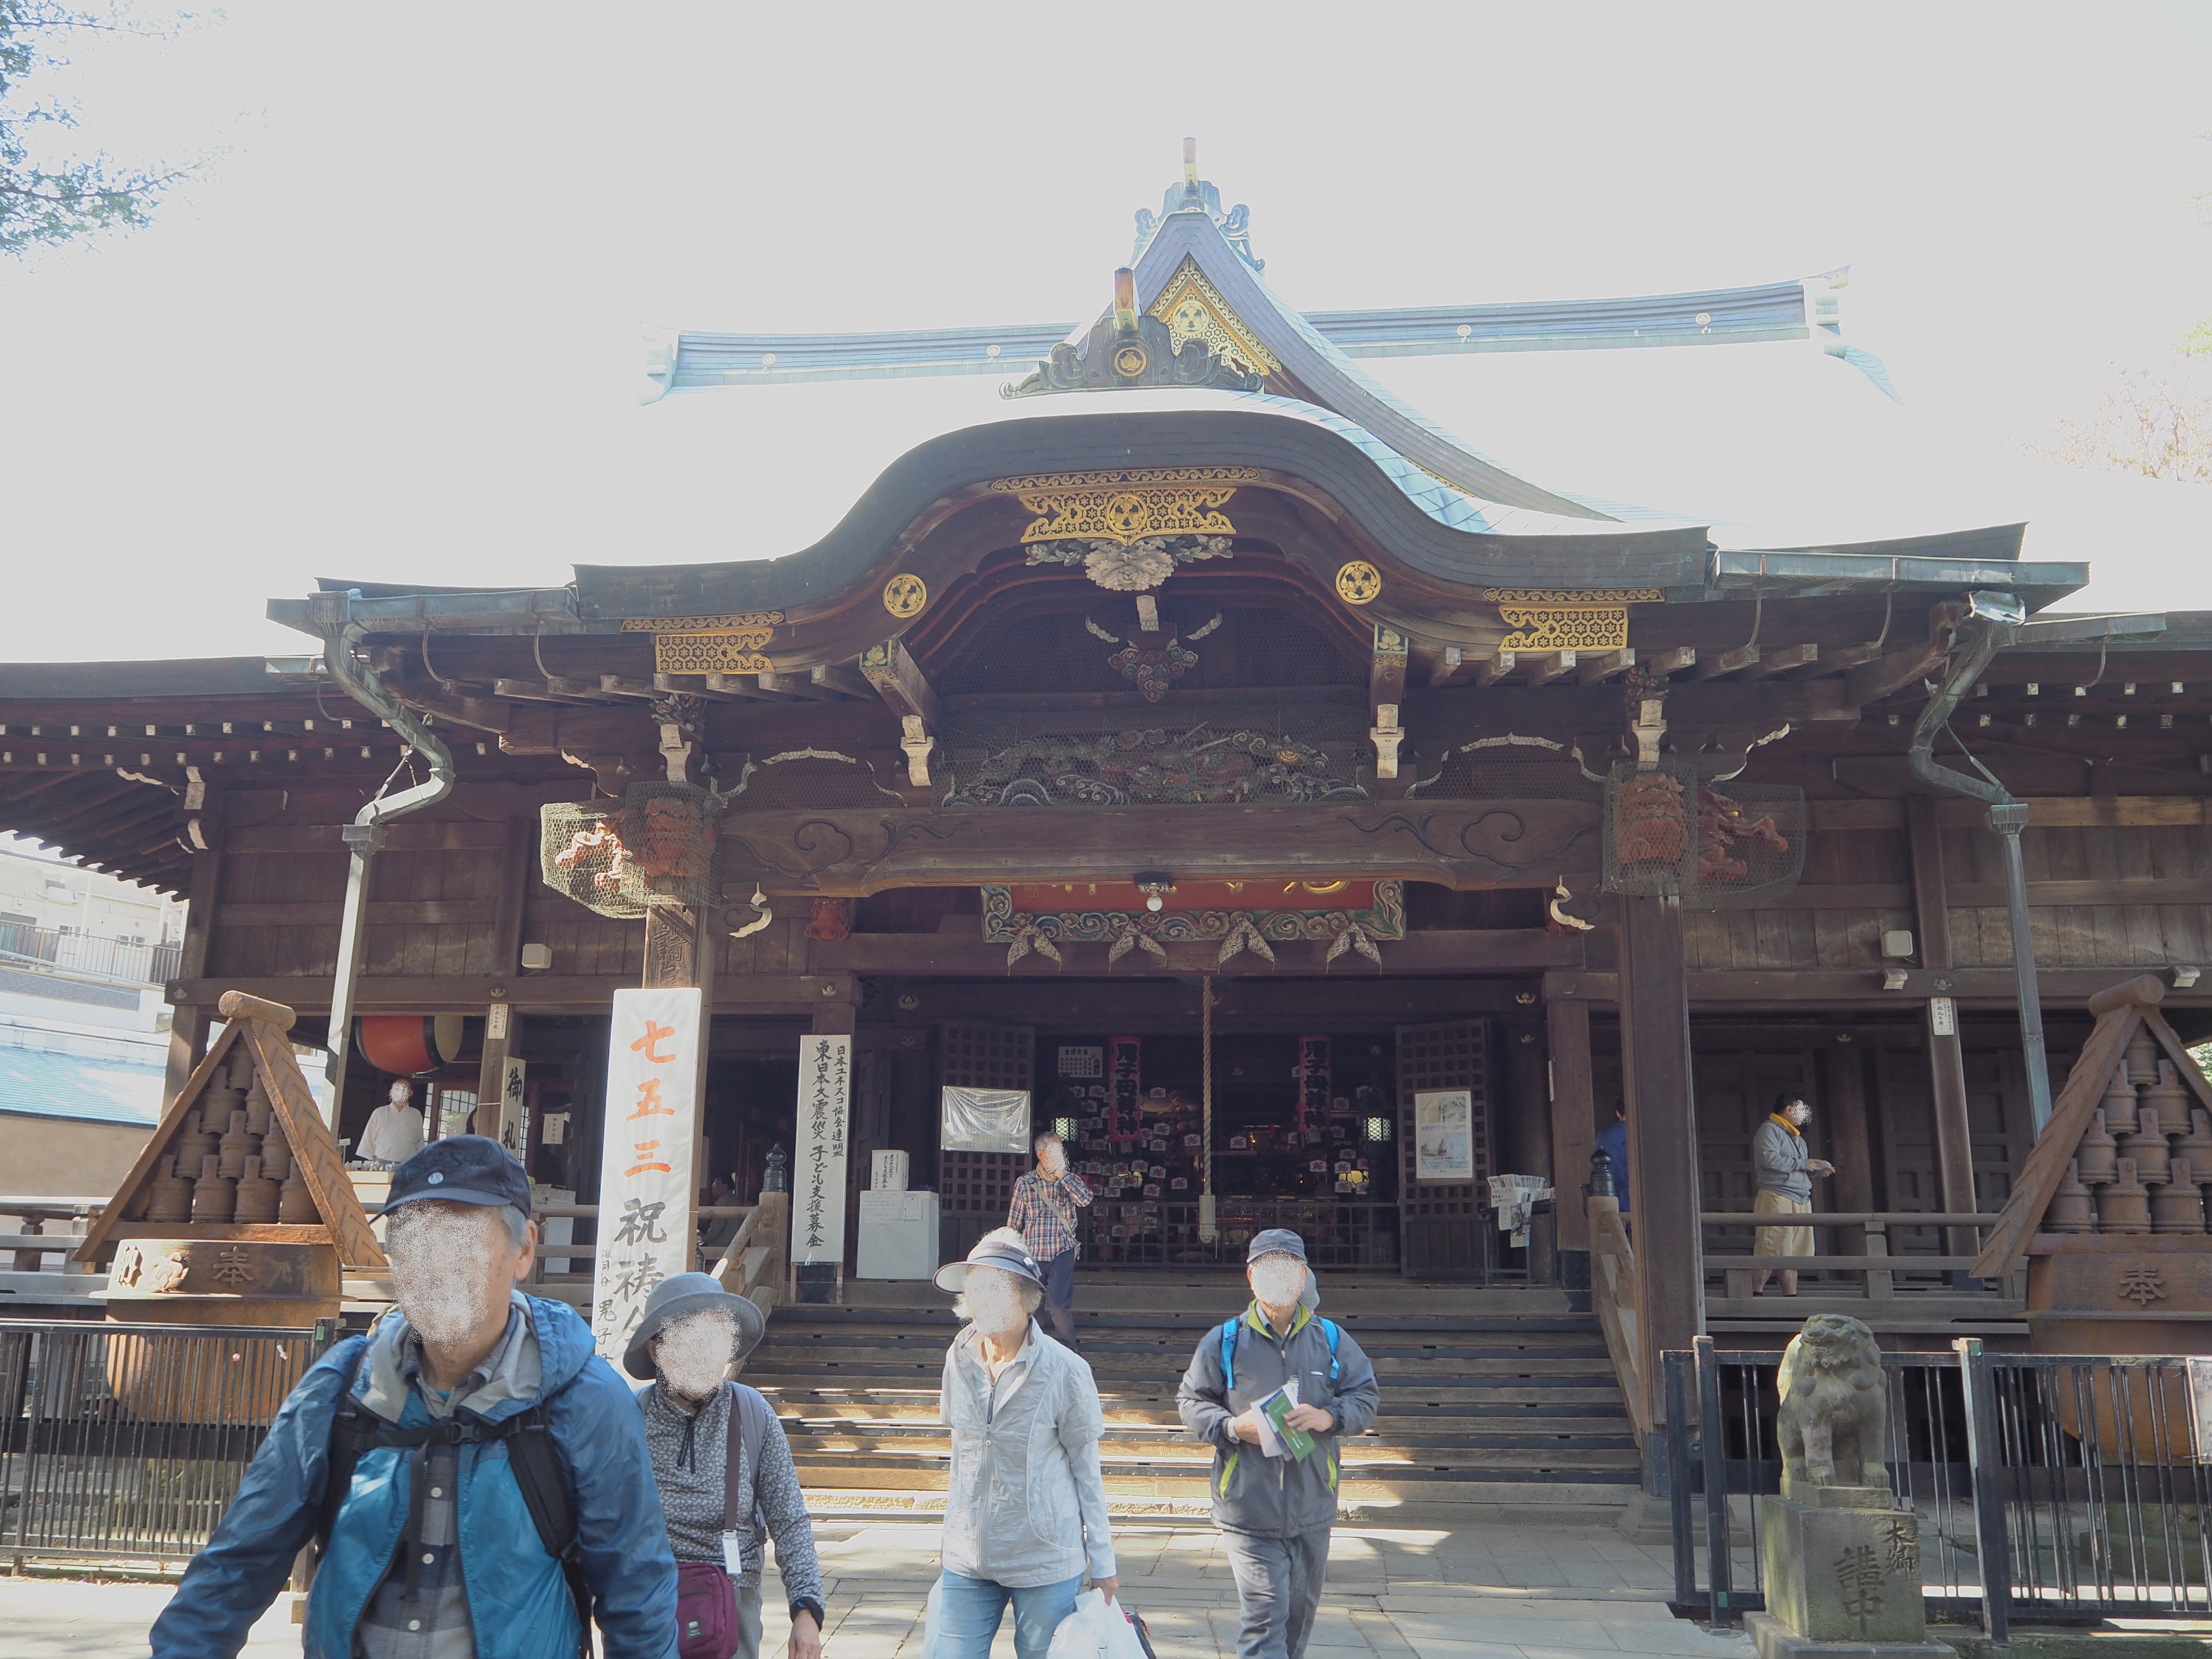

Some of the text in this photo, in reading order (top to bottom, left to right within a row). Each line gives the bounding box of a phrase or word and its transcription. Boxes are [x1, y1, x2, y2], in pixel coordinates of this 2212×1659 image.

[503, 1067, 522, 1150] 御札
[805, 1039, 832, 1247] 東日本大震災 子ども支援募金
[831, 1045, 847, 1157] 日本ユネスコ協会連盟
[211, 1246, 255, 1287] 奉
[2118, 1260, 2169, 1307] 奉
[1833, 1545, 1886, 1634] 講中
